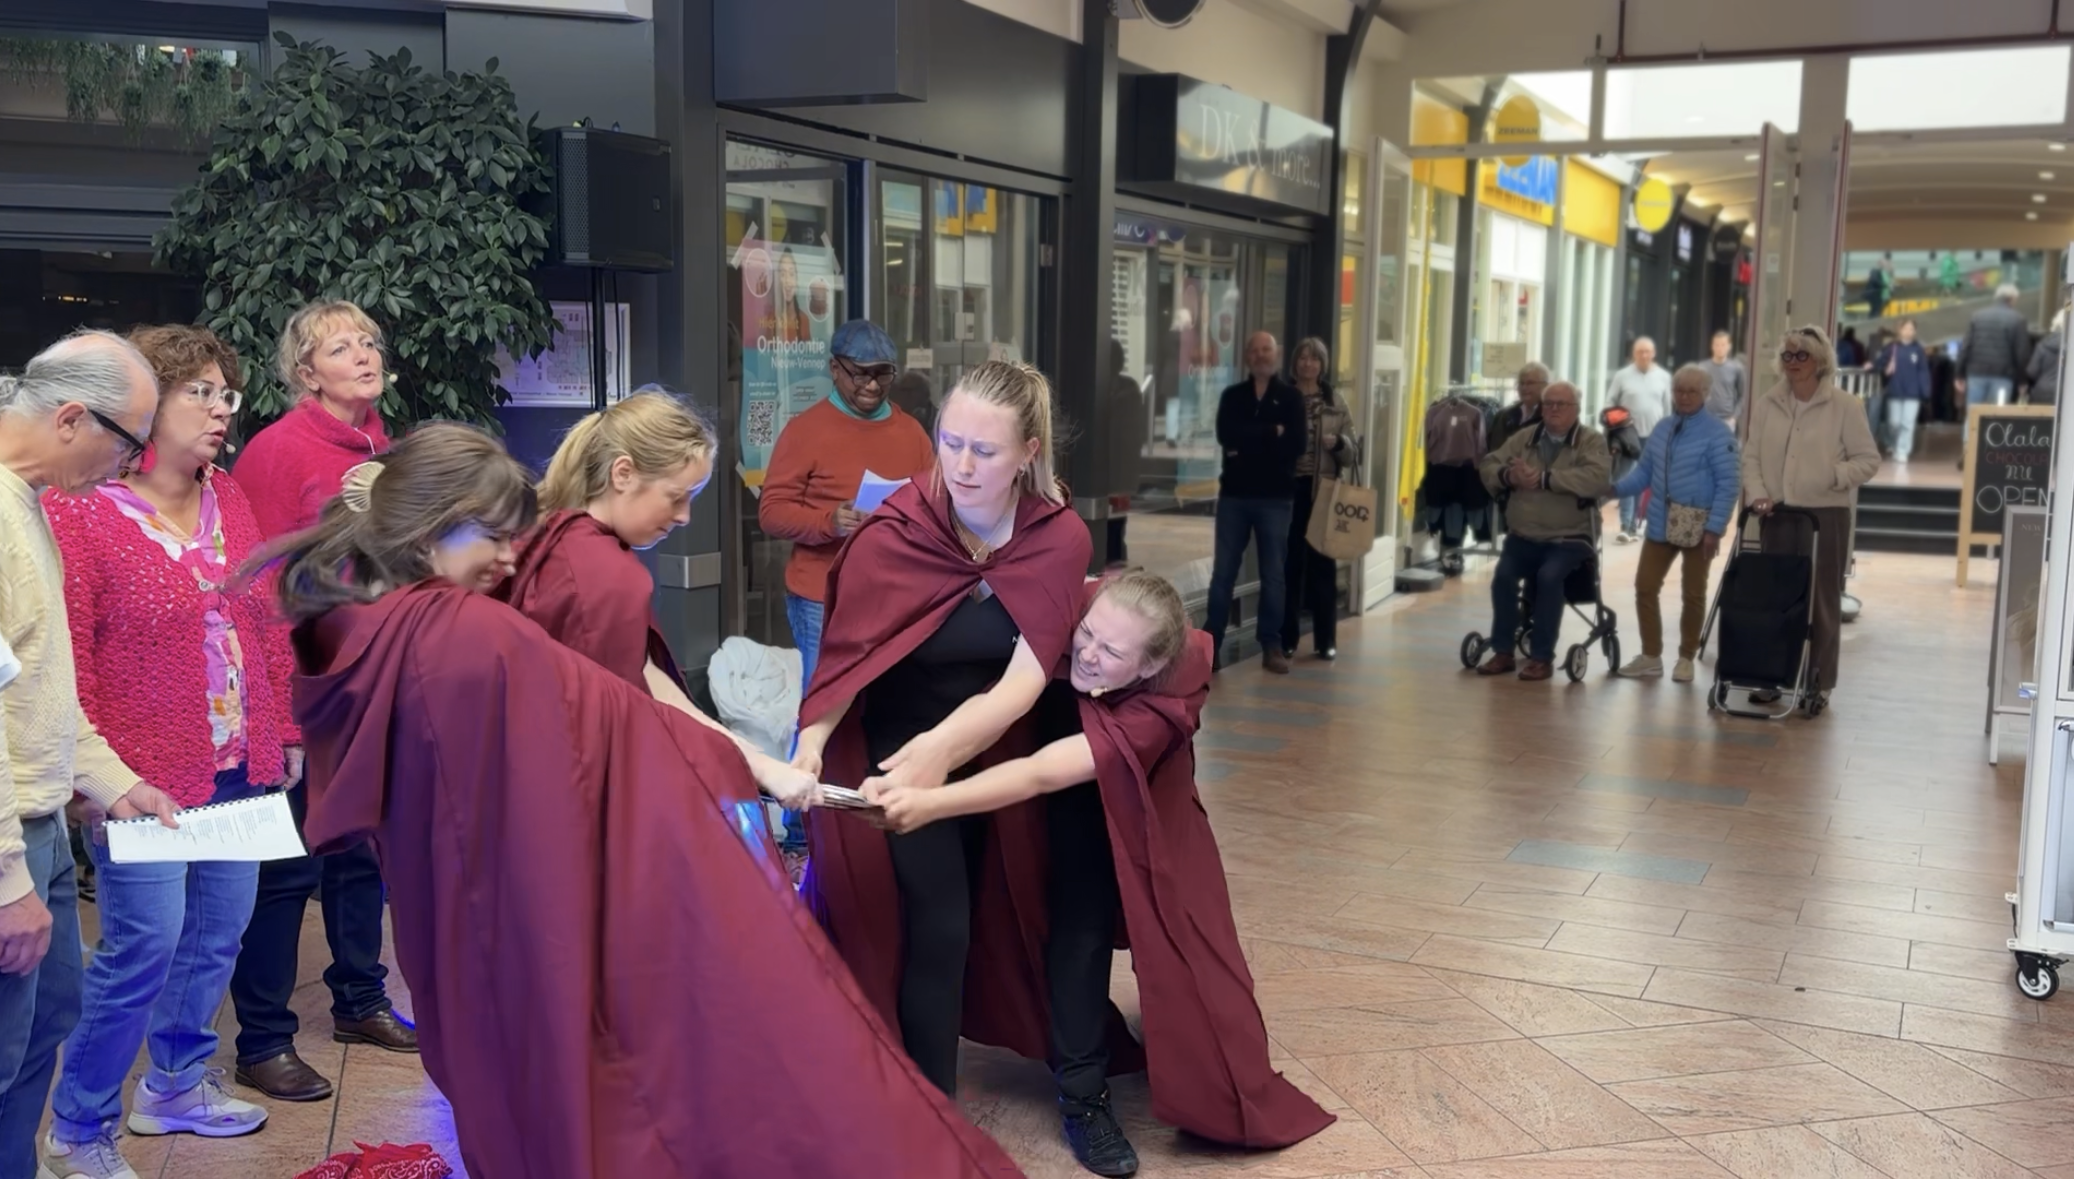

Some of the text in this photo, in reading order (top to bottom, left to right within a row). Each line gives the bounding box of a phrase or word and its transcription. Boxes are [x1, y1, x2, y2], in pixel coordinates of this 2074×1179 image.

[1497, 127, 1539, 135] ZEEMAN
[1199, 104, 1320, 189] DK & more...
[757, 335, 825, 354] Orthodontie
[771, 357, 827, 370] Nieuw-Vennep
[1985, 422, 2051, 449] Olala
[1976, 485, 2048, 514] OPEN
